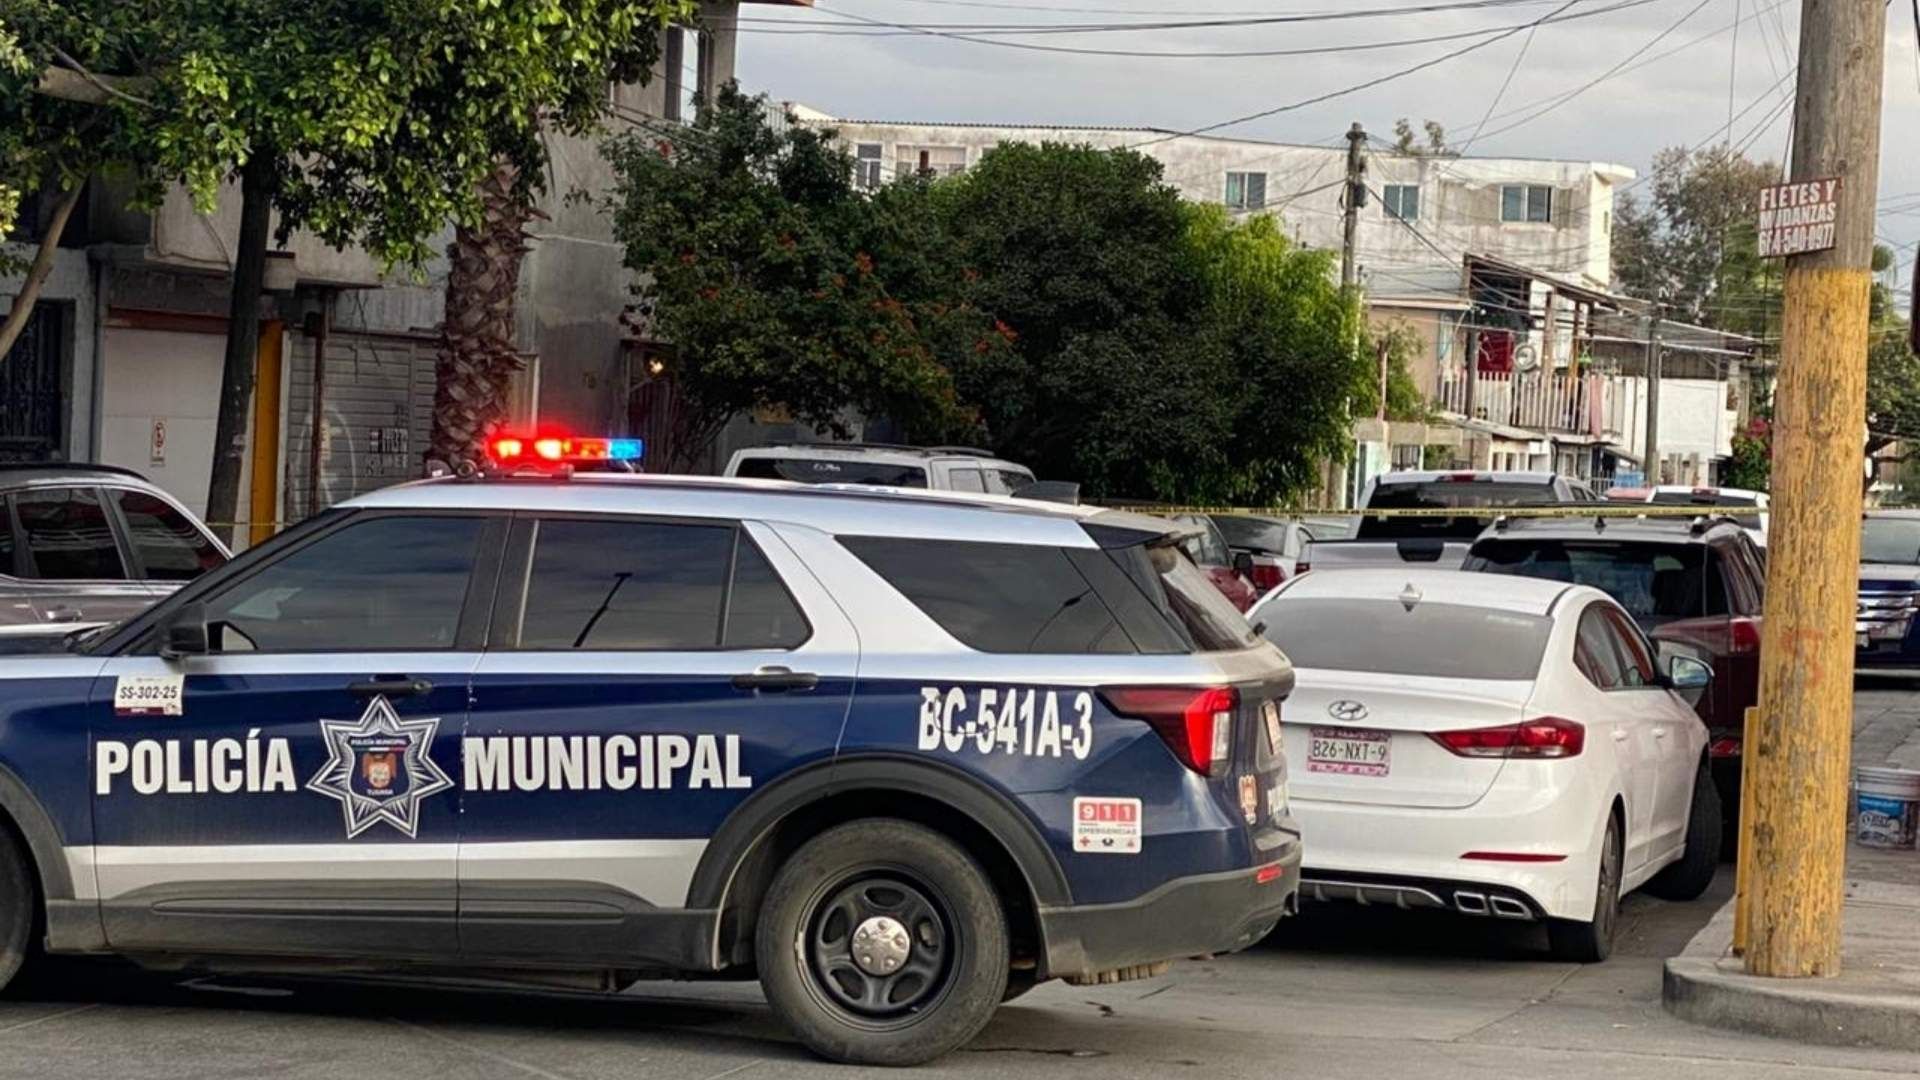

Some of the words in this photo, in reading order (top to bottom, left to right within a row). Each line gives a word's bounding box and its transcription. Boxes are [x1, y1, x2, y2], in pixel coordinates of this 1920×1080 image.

[1760, 182, 1821, 210] FLETES
[1826, 180, 1837, 201] Y
[1760, 202, 1837, 230] MUDANZAS
[120, 686, 178, 699] SS-302-25
[918, 687, 1093, 761] BC-541A-3
[96, 728, 297, 795] POLICÍA
[464, 734, 752, 791] MUNICIPAL
[1082, 804, 1131, 820] 911
